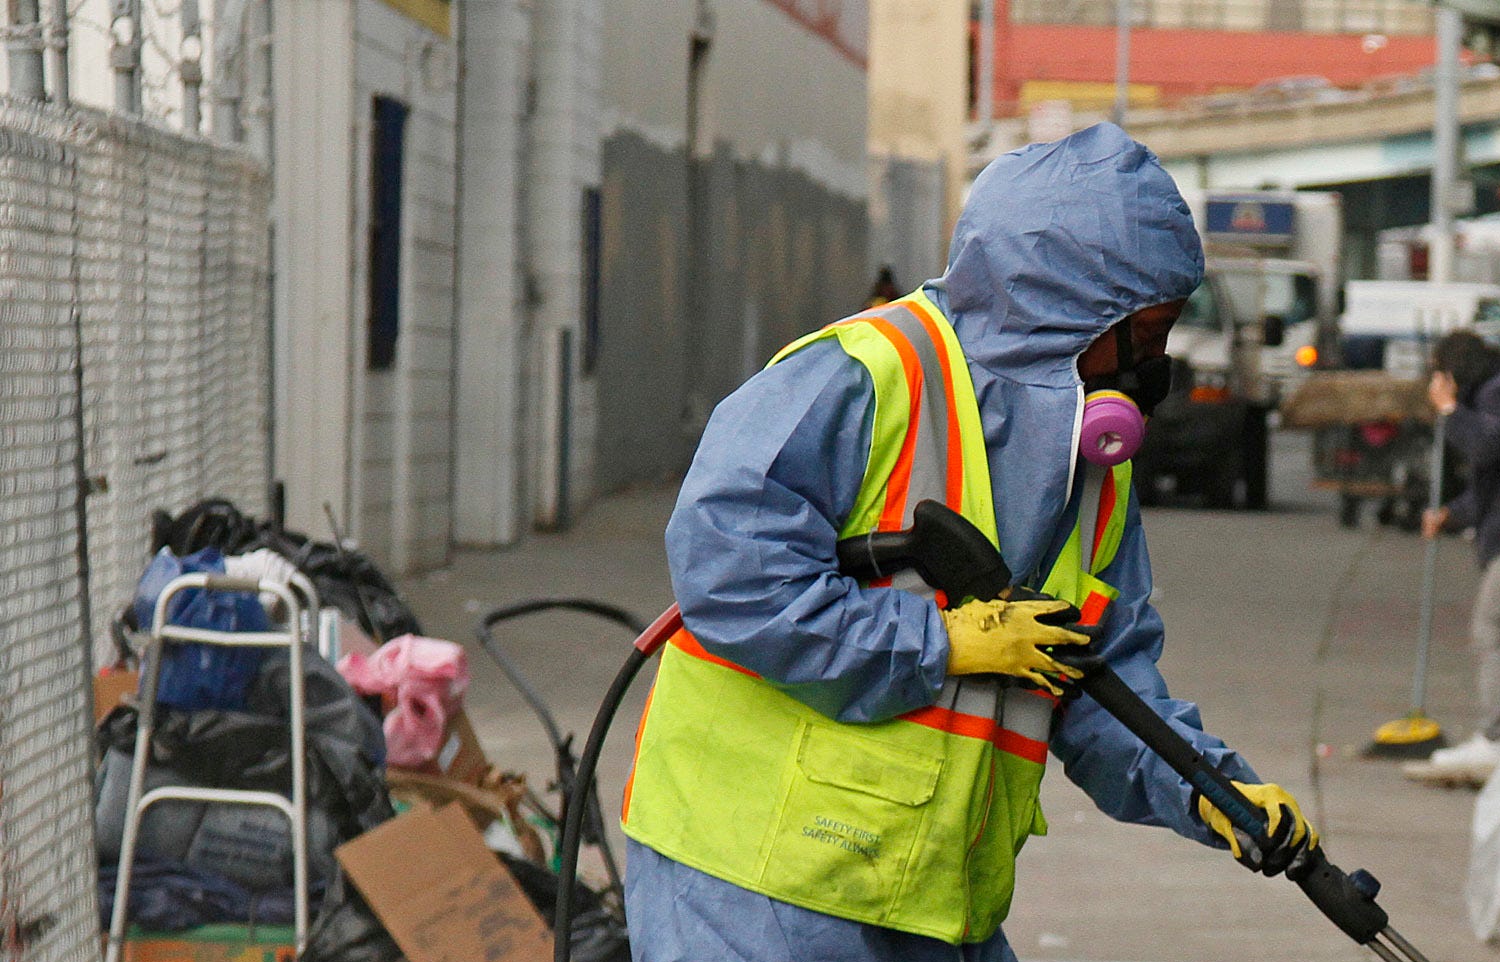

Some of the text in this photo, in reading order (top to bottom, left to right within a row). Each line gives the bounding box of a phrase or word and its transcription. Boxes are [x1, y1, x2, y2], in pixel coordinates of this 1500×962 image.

[802, 826, 839, 846] SAFETY
[815, 815, 881, 844] SAFETY FIRST
